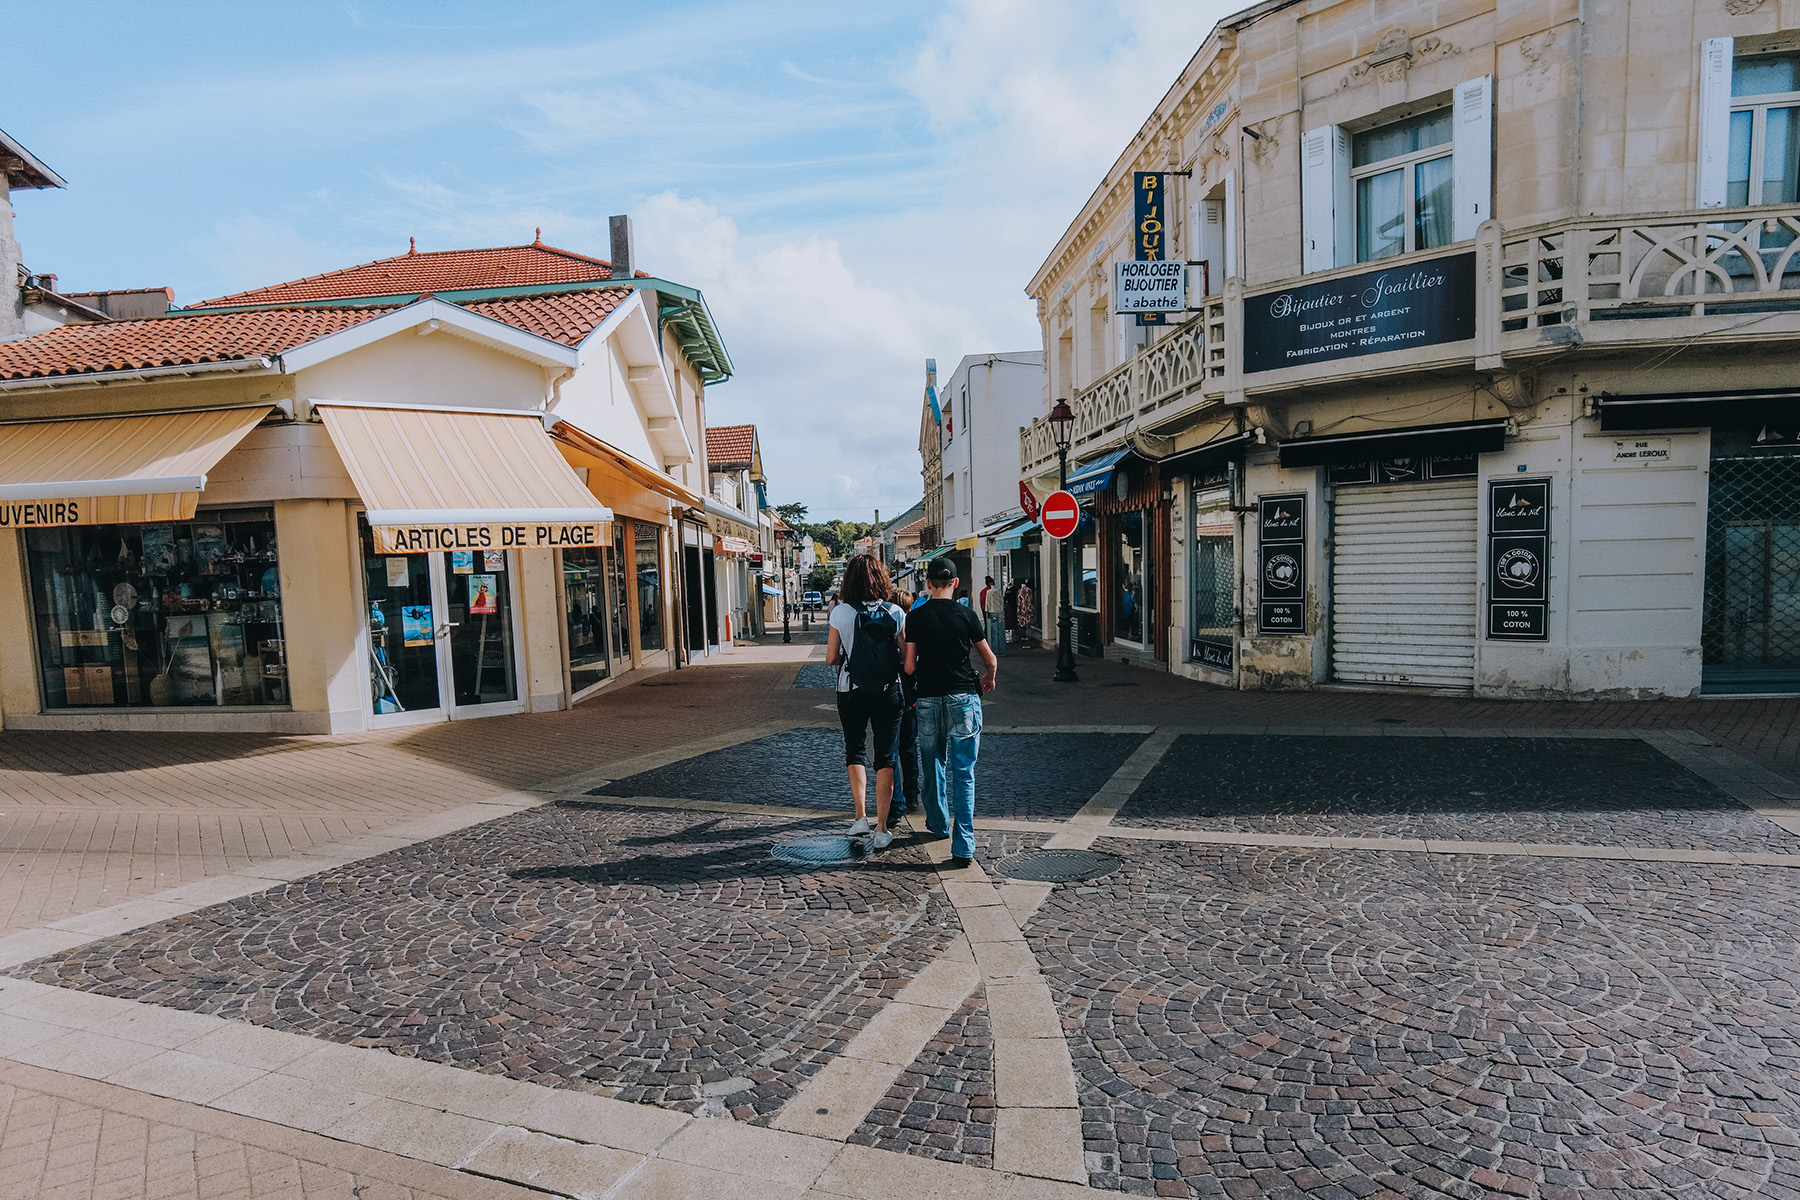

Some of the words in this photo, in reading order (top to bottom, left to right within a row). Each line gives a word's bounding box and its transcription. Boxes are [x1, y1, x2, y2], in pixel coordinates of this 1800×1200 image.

[1121, 263, 1181, 277] HORLOGER
[1124, 278, 1178, 292] BIJOUTIER
[1269, 293, 1344, 319] Bijoutier
[1360, 271, 1447, 308] Joaillier
[1299, 319, 1335, 332] BIJOUX
[1338, 317, 1352, 325] OR
[1355, 314, 1367, 323] ET
[1370, 306, 1411, 320] ARGENT
[1330, 325, 1376, 339] MONTRES
[1286, 342, 1348, 358] FABRICATION
[1359, 329, 1426, 346] RÉPARATION
[1639, 449, 1668, 457] LEROUX
[0, 502, 79, 526] UVENIRS
[395, 526, 491, 550] ARTICLES
[501, 526, 527, 546] DE
[535, 525, 595, 546] PLAGE
[1511, 550, 1533, 560] COTON
[1270, 616, 1293, 624] COTON
[1506, 610, 1520, 618] 100
[1521, 610, 1529, 618] %
[1502, 621, 1531, 629] COTON
